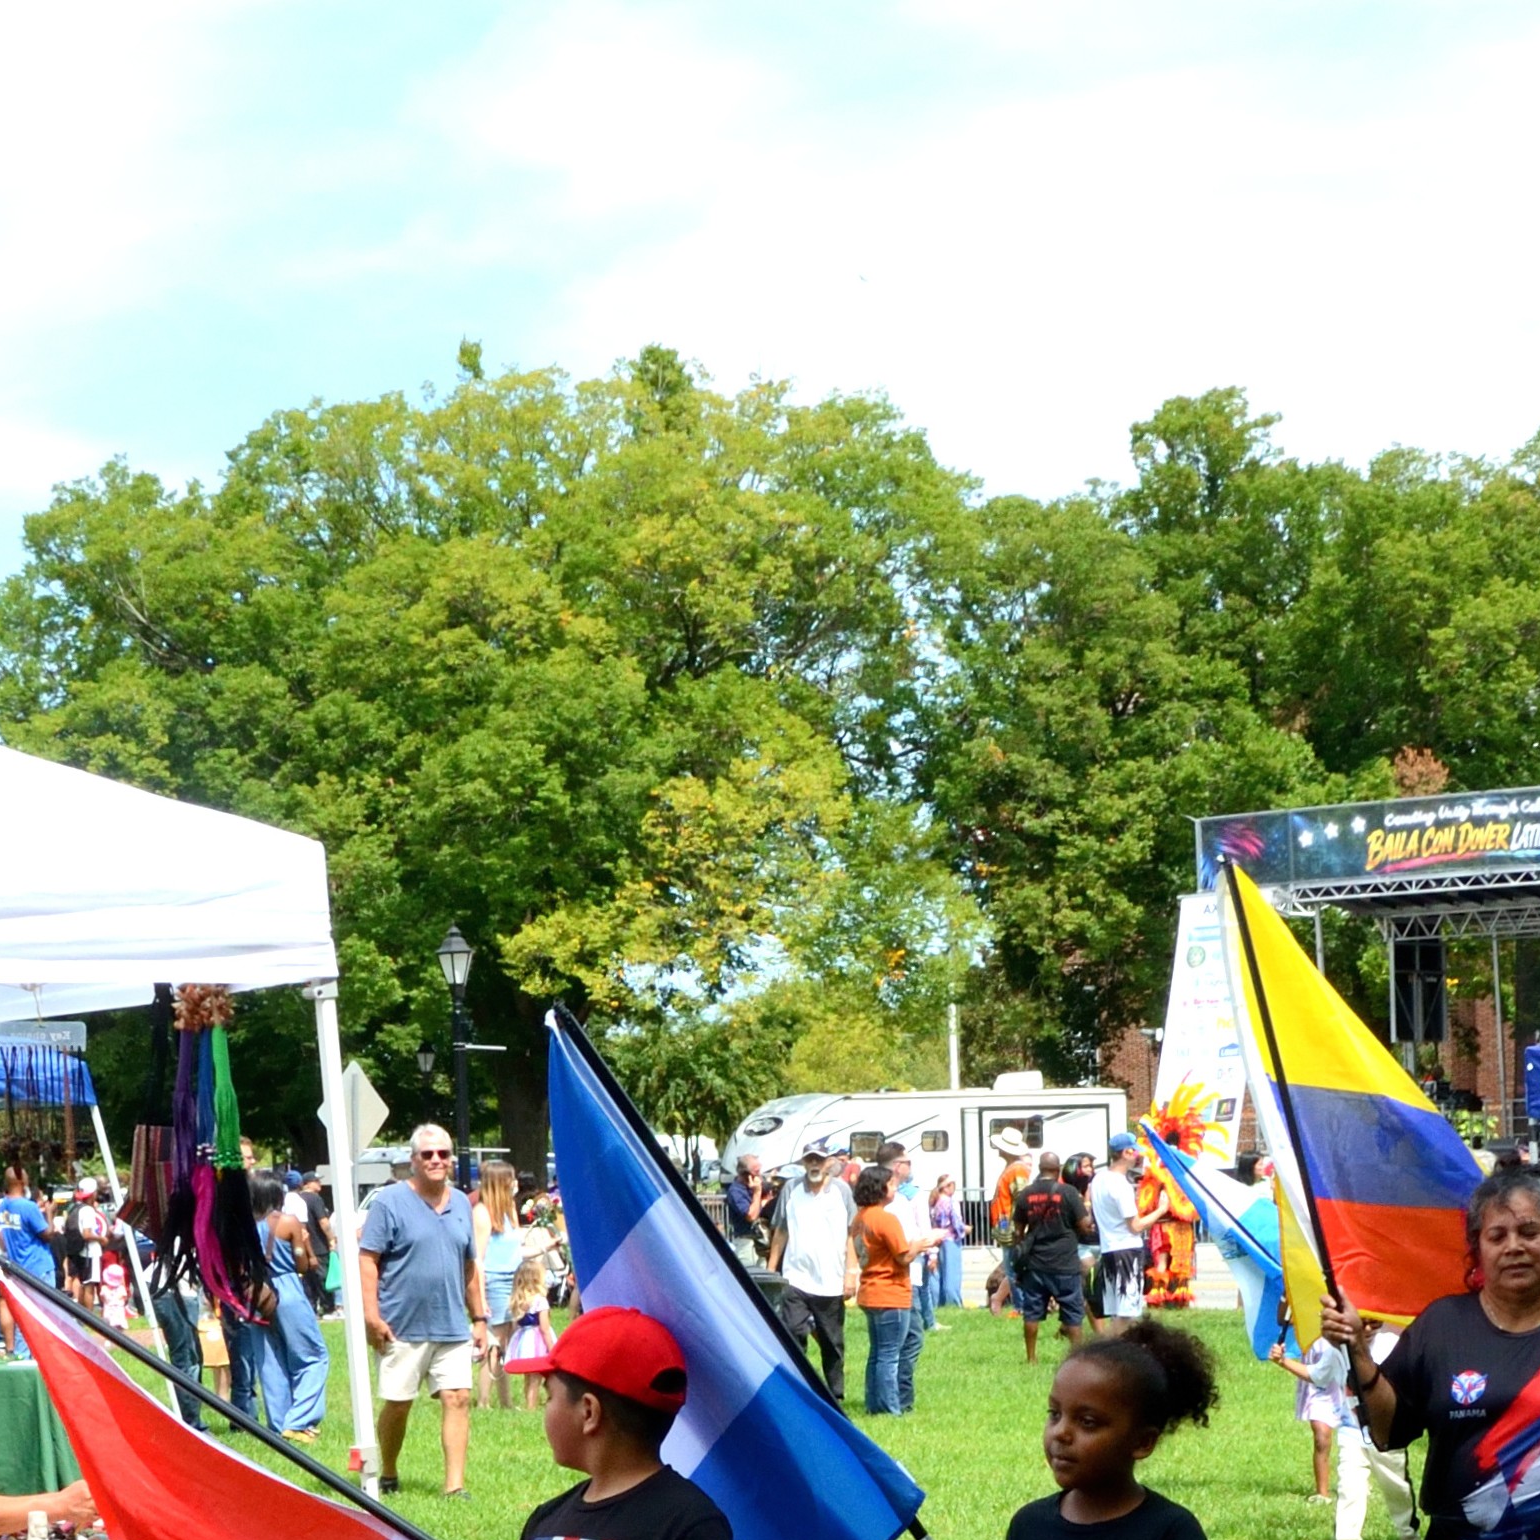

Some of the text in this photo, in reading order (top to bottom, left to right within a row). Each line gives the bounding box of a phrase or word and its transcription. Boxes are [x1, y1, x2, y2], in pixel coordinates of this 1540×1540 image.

[1438, 804, 1471, 822] Unity
[1459, 821, 1511, 855] DOVER
[1449, 1409, 1487, 1420] PANAMA
